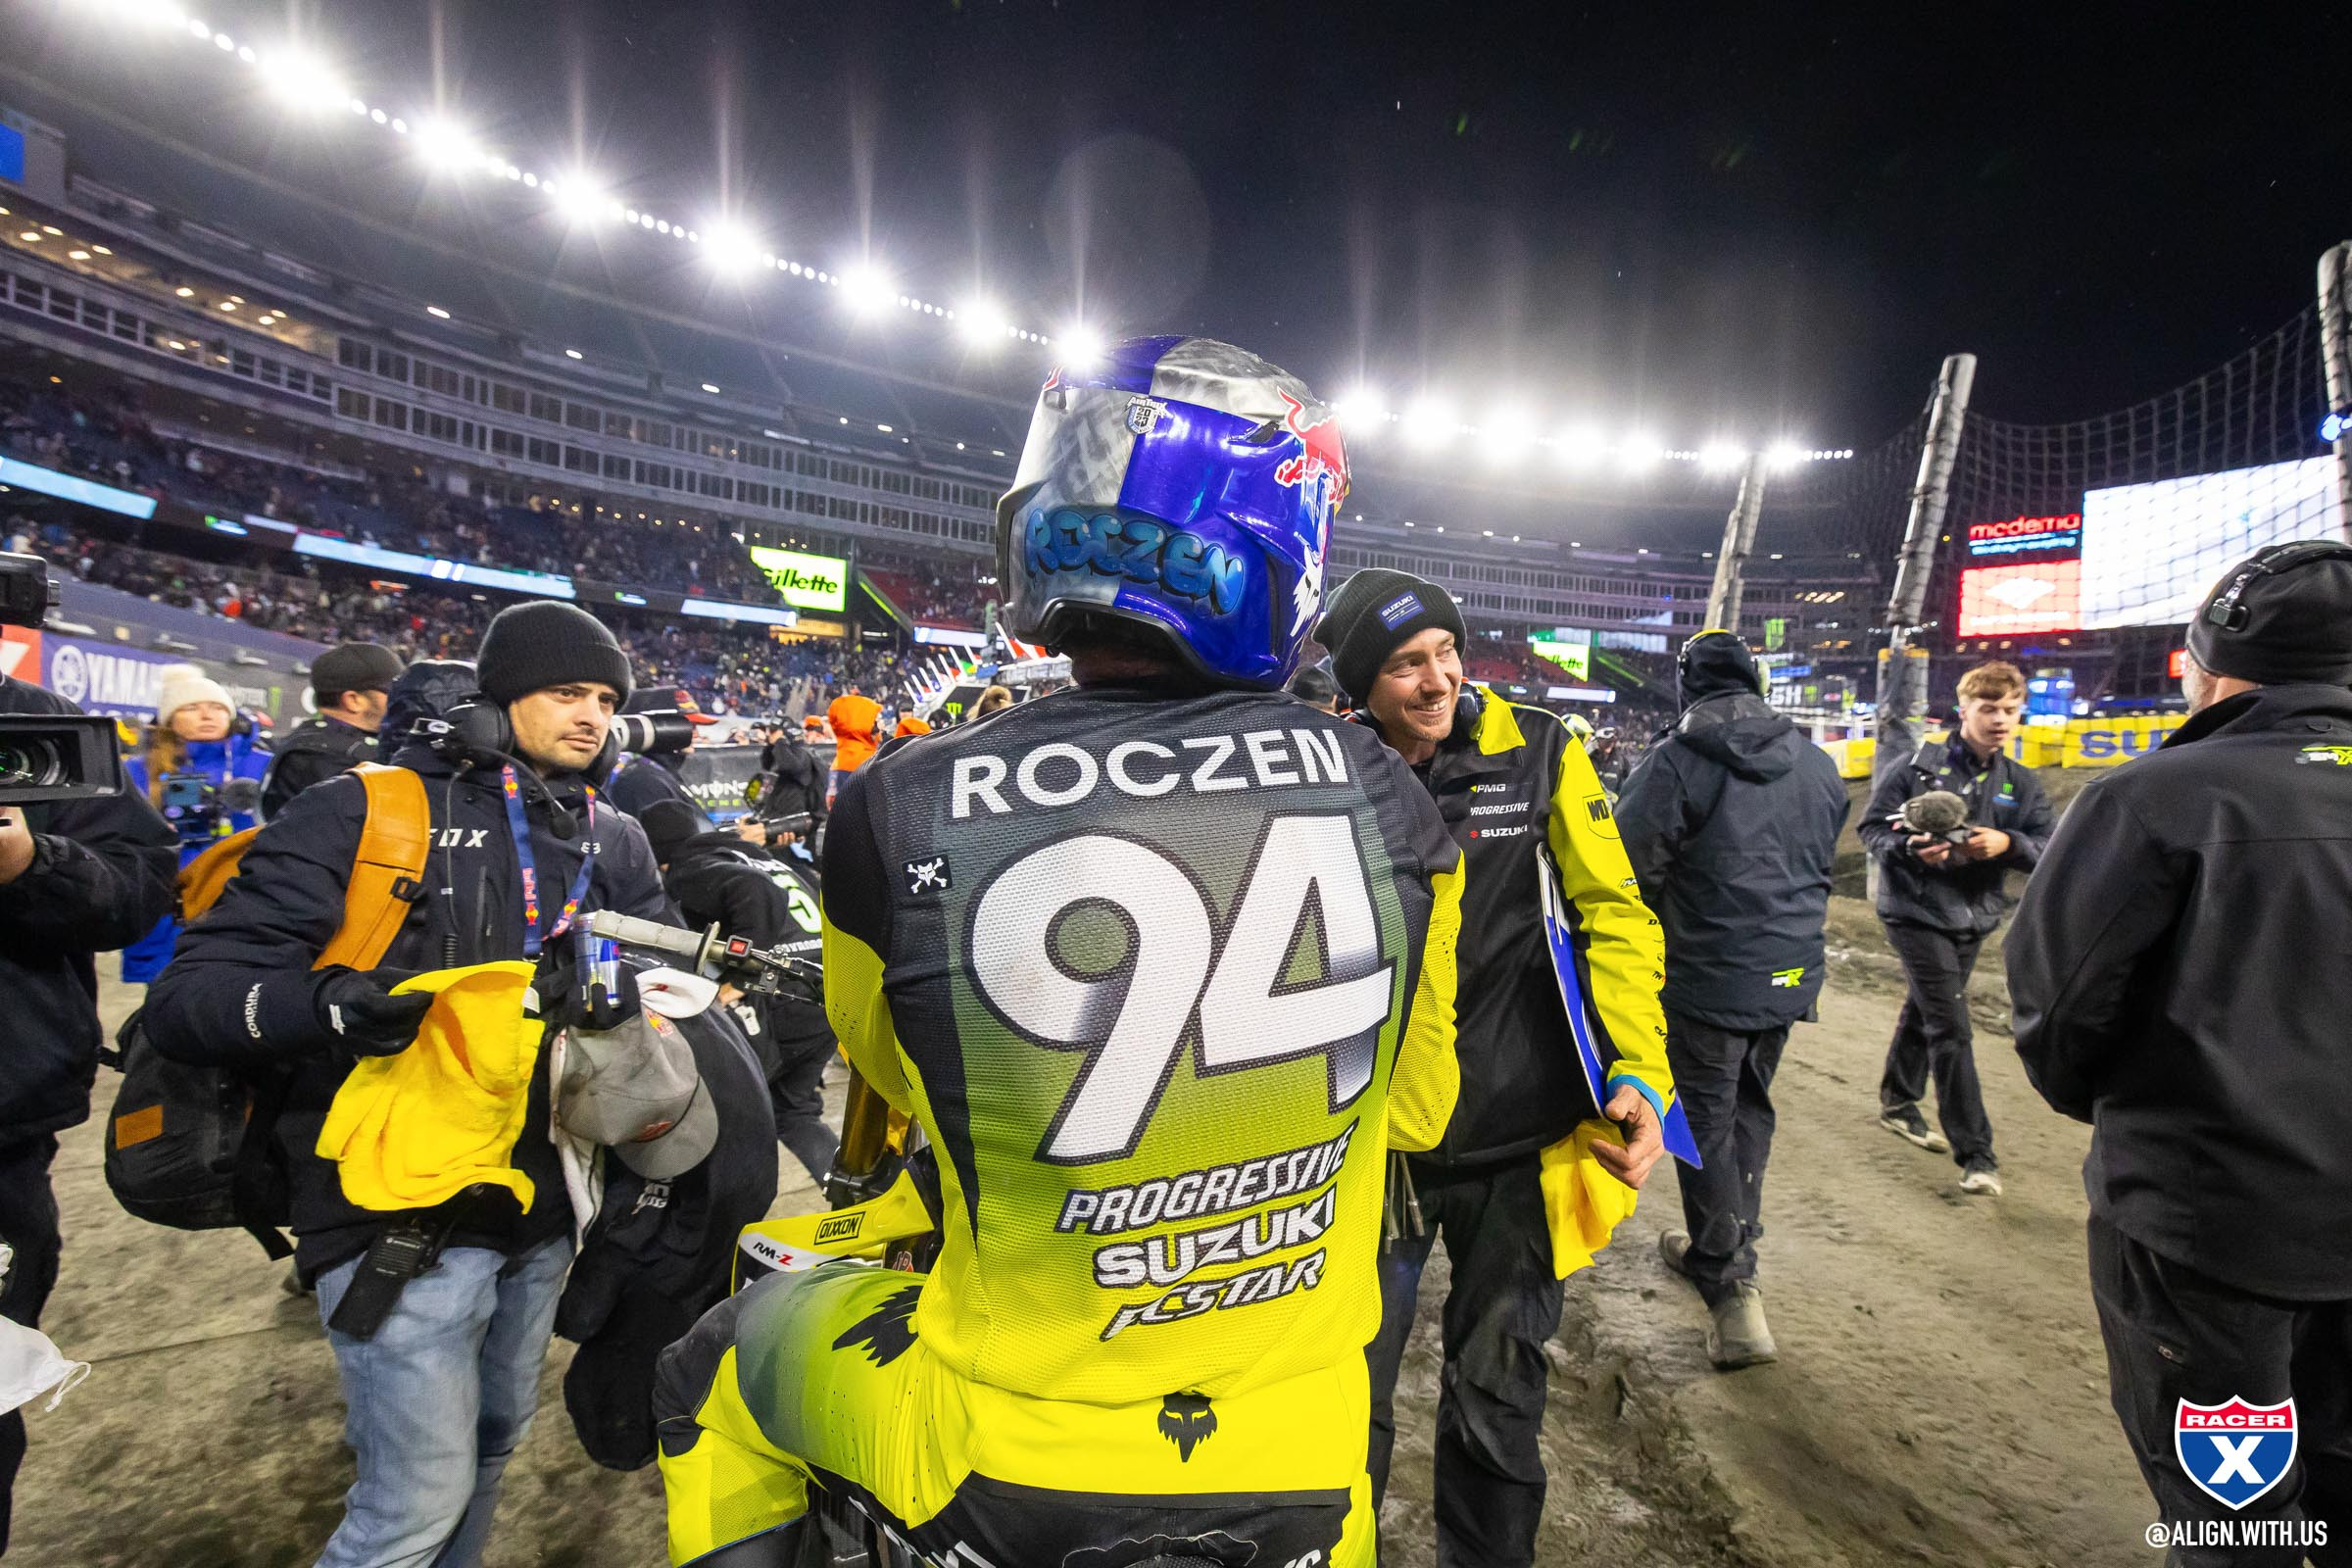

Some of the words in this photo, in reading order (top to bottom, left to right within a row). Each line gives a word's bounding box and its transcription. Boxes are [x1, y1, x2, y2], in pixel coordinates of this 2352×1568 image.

[1382, 595, 1414, 616] SUZUKI
[953, 727, 1348, 819] ROCZEN
[1477, 784, 1506, 793] PMG
[1481, 824, 1528, 838] SUZUKI
[965, 810, 1396, 1163] 94
[1056, 1118, 1358, 1234] PROGRESSIVE
[818, 1217, 858, 1239] DIXXON
[1094, 1184, 1336, 1287] SUZUKI
[753, 1242, 794, 1266] RM-Z
